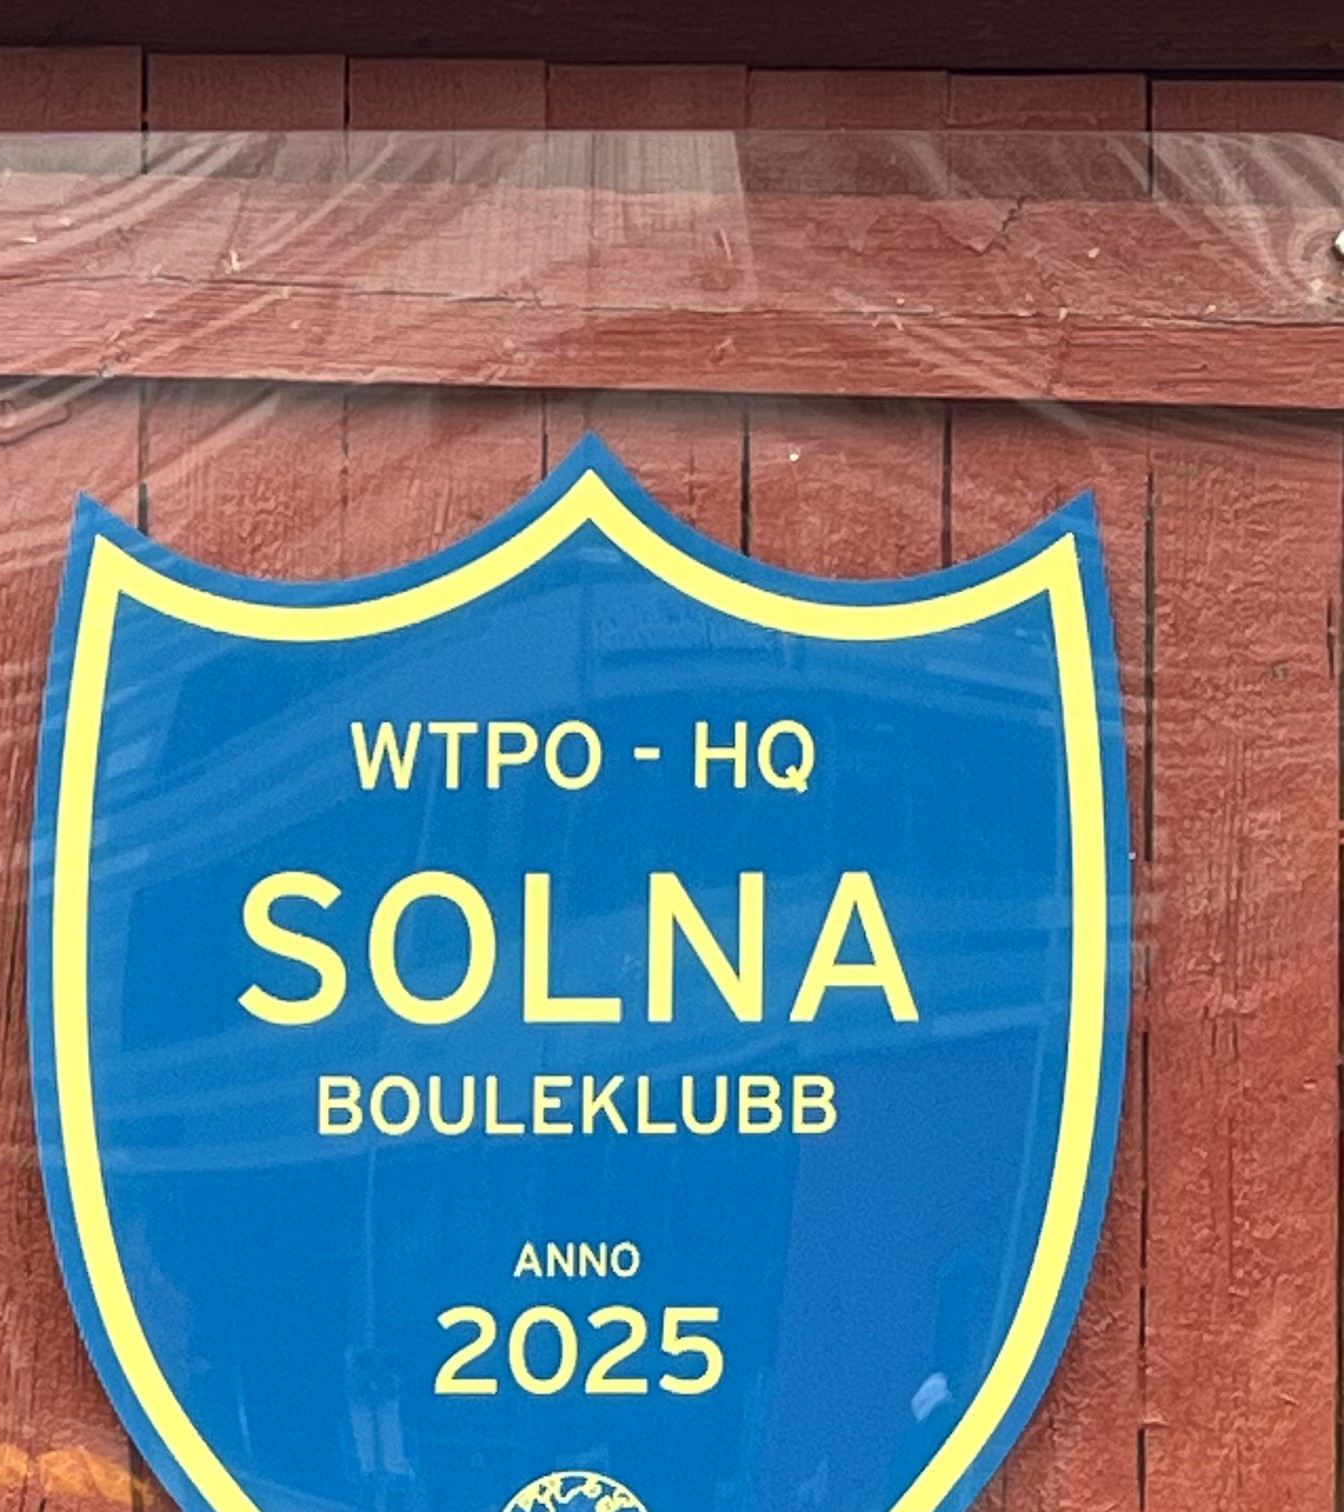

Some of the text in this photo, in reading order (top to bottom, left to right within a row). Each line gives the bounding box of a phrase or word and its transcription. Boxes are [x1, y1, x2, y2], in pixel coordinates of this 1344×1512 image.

[350, 719, 603, 790] WTPO
[694, 719, 816, 794] HQ
[237, 870, 920, 1027] SOLNA
[317, 1074, 838, 1136] BOULEKLUBB
[512, 1241, 641, 1278] ANNO
[433, 1304, 725, 1396] 2025
